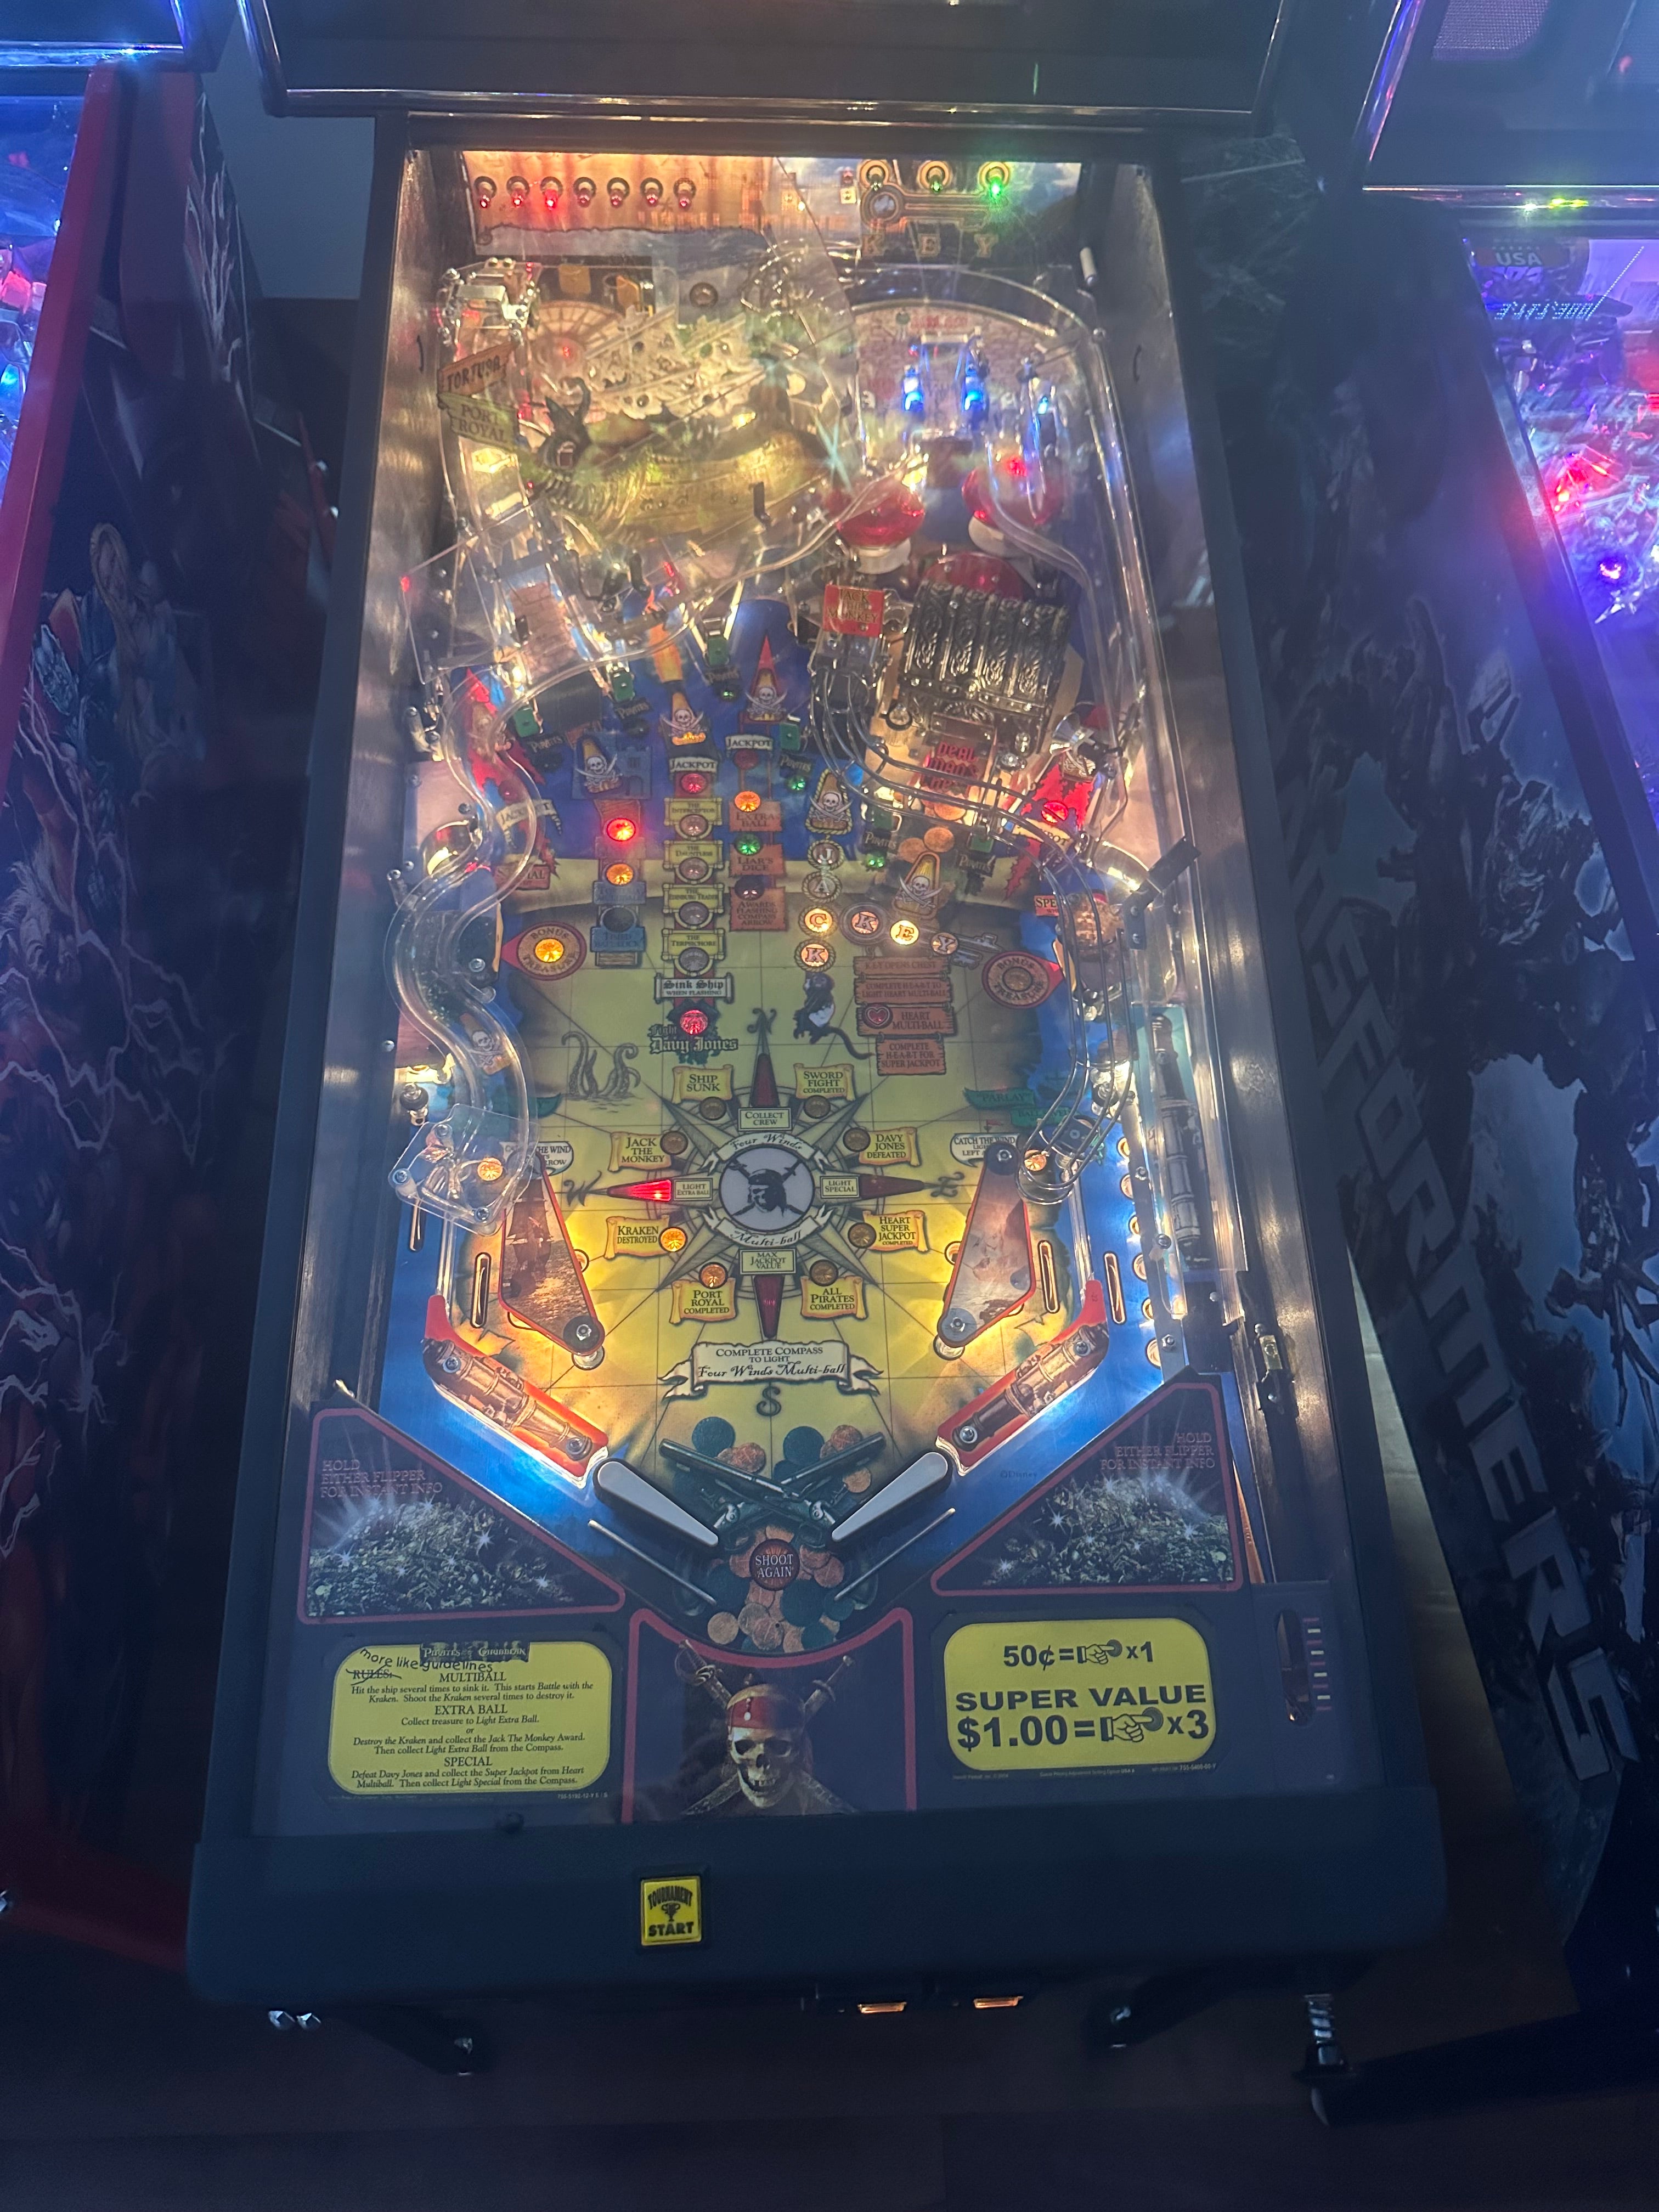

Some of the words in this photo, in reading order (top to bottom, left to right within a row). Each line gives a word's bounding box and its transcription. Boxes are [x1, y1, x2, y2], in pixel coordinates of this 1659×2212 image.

[726, 738, 772, 747] JACKPOT
[671, 760, 716, 769] JACKPOT
[810, 913, 827, 927] C
[529, 927, 571, 940] BONUS
[857, 914, 876, 932] K
[898, 924, 914, 941] E
[939, 936, 956, 953] Y
[808, 947, 829, 960] K
[522, 952, 577, 973] TREASURE
[996, 957, 1035, 971] BONUS
[663, 980, 692, 990] Sink
[696, 980, 724, 990] Ship
[993, 979, 1045, 1002] TREASURE
[901, 1011, 931, 1020] HEART
[892, 1021, 943, 1030] MULTI-BALL
[650, 1036, 690, 1054] Davy
[693, 1036, 738, 1052] Jones
[889, 1042, 930, 1051] COMPLETE
[881, 1059, 905, 1068] SUPER
[907, 1058, 940, 1068] JACKPOT
[689, 1073, 718, 1084] SHIP
[803, 1070, 843, 1080] SWORD
[686, 1082, 720, 1092] SUNK
[807, 1078, 840, 1088] FIGHT
[803, 1086, 845, 1094] COMPLETED
[744, 1110, 785, 1120] COLLECT
[753, 1118, 778, 1126] CREW
[625, 1136, 657, 1149] JACK
[730, 1137, 758, 1150] Four
[763, 1133, 803, 1150] Winds
[876, 1133, 904, 1143] DAVY
[953, 1137, 980, 1146] CATCH
[980, 1137, 993, 1145] THE
[550, 1145, 572, 1153] WIND
[631, 1147, 654, 1156] THE
[874, 1141, 906, 1152] JONES
[620, 1154, 665, 1164] MONKEY
[866, 1150, 907, 1160] DEFEATED
[879, 1216, 911, 1225] HEART
[617, 1226, 659, 1235] KRAKEN
[617, 1235, 658, 1244] DESTROYED
[730, 1229, 802, 1246] Multi-ball
[878, 1232, 916, 1241] JACKPOT
[750, 1256, 787, 1265] JACKPOT
[693, 1290, 723, 1299] PORT
[810, 1294, 855, 1304] PIRATES
[691, 1298, 725, 1307] ROYAL
[809, 1302, 855, 1311] COMPLETED
[684, 1306, 730, 1314] COMPLETED
[715, 1348, 773, 1358] COMPLETE
[775, 1347, 823, 1356] COMPASS
[697, 1366, 727, 1378] Four
[731, 1364, 773, 1377] Winds
[775, 1362, 847, 1376] Multi-ball
[1175, 1432, 1212, 1443] HOLD
[1115, 1446, 1162, 1458] EITHER
[1164, 1446, 1215, 1457] FLIPPER
[322, 1459, 360, 1471] HOLD
[1100, 1459, 1126, 1470] FOR
[1128, 1458, 1183, 1470] INSTANT
[1185, 1458, 1216, 1469] INFO
[321, 1471, 370, 1485] EITHER
[373, 1470, 426, 1482] FLIPPER
[320, 1486, 348, 1498] FOR
[349, 1483, 409, 1497] INSTANT
[410, 1482, 443, 1494] INFO
[755, 1554, 794, 1566] SHOOT
[757, 1566, 793, 1578] AGAIN
[1126, 1641, 1154, 1663] x1
[360, 1648, 393, 1667] more
[396, 1656, 419, 1669] like
[439, 1672, 507, 1683] MULTIBALL
[351, 1686, 365, 1694] Hit
[366, 1686, 380, 1694] the
[381, 1685, 398, 1695] ship
[399, 1684, 427, 1693] several
[429, 1685, 450, 1693] times
[462, 1683, 479, 1692] sink
[494, 1683, 512, 1691] This
[514, 1683, 535, 1691] starts
[537, 1681, 561, 1690] Battle
[562, 1681, 580, 1690] with
[582, 1681, 594, 1689] the
[369, 1695, 399, 1703] Kraken.
[403, 1694, 427, 1702] Shoot
[428, 1693, 442, 1702] the
[443, 1693, 471, 1702] Kraken
[473, 1692, 501, 1701] several
[503, 1692, 523, 1700] times
[526, 1692, 534, 1700] to
[535, 1691, 564, 1701] destroy
[566, 1691, 575, 1699] it.
[955, 1689, 1079, 1712] SUPER
[1088, 1684, 1207, 1707] VALUE
[435, 1705, 475, 1716] EXTRA
[478, 1704, 508, 1715] BALL
[1167, 1709, 1209, 1740] x3
[353, 1737, 383, 1747] Destroy
[385, 1737, 397, 1745] the
[398, 1736, 427, 1745] Kraken
[428, 1736, 443, 1744] and
[445, 1735, 472, 1743] collect
[473, 1734, 487, 1743] the
[488, 1734, 505, 1743] Jack
[508, 1734, 523, 1742] The
[524, 1733, 555, 1743] Monkey
[557, 1733, 585, 1741] Award.
[444, 1757, 493, 1767] SPECIAL
[648, 1921, 695, 1937] START
